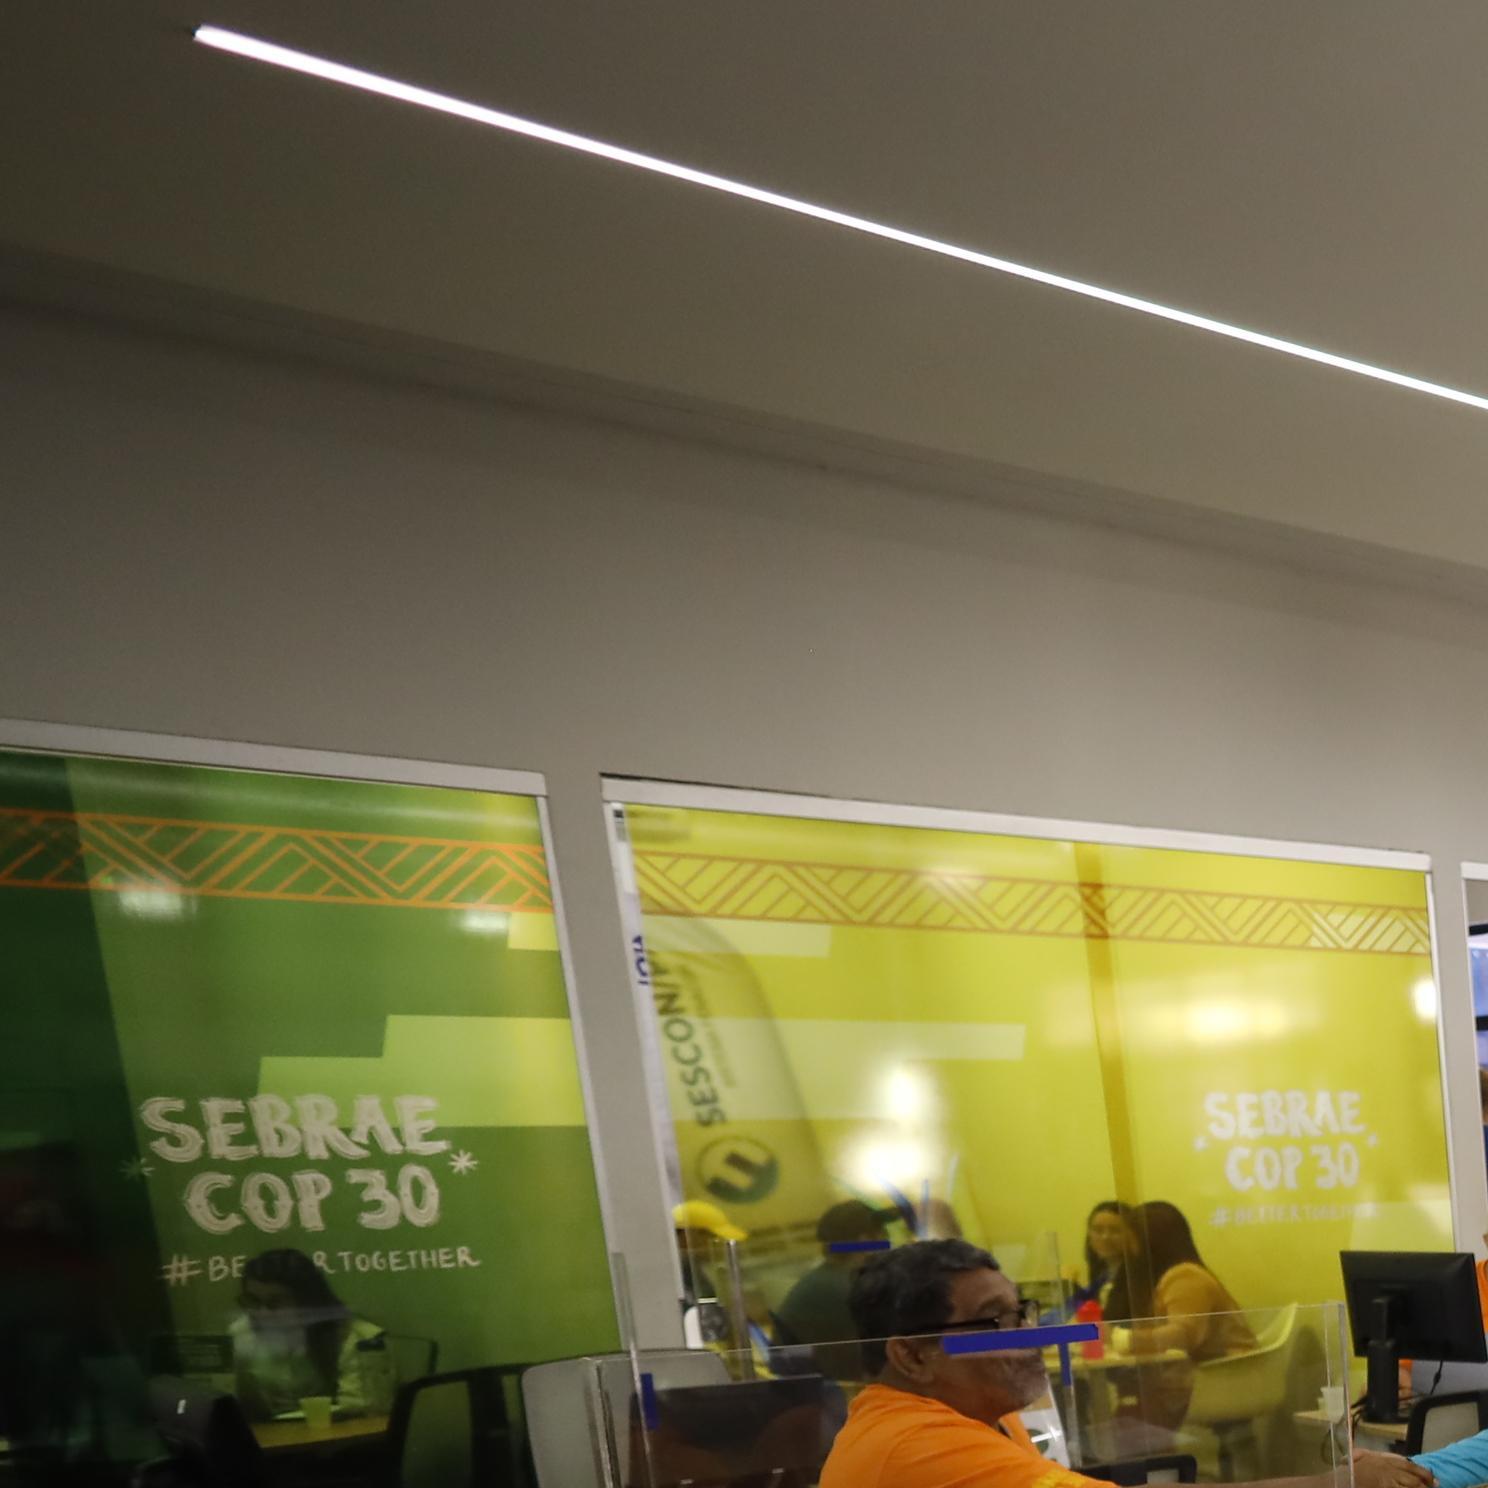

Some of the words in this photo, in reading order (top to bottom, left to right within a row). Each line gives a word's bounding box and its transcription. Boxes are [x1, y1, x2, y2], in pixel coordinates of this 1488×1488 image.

[141, 1094, 452, 1162] SEBRAE
[1204, 1088, 1367, 1140] SEBRAE
[1225, 1145, 1304, 1191] COP
[1310, 1141, 1360, 1190] 30
[184, 1169, 332, 1234] COP
[346, 1162, 441, 1230] 30
